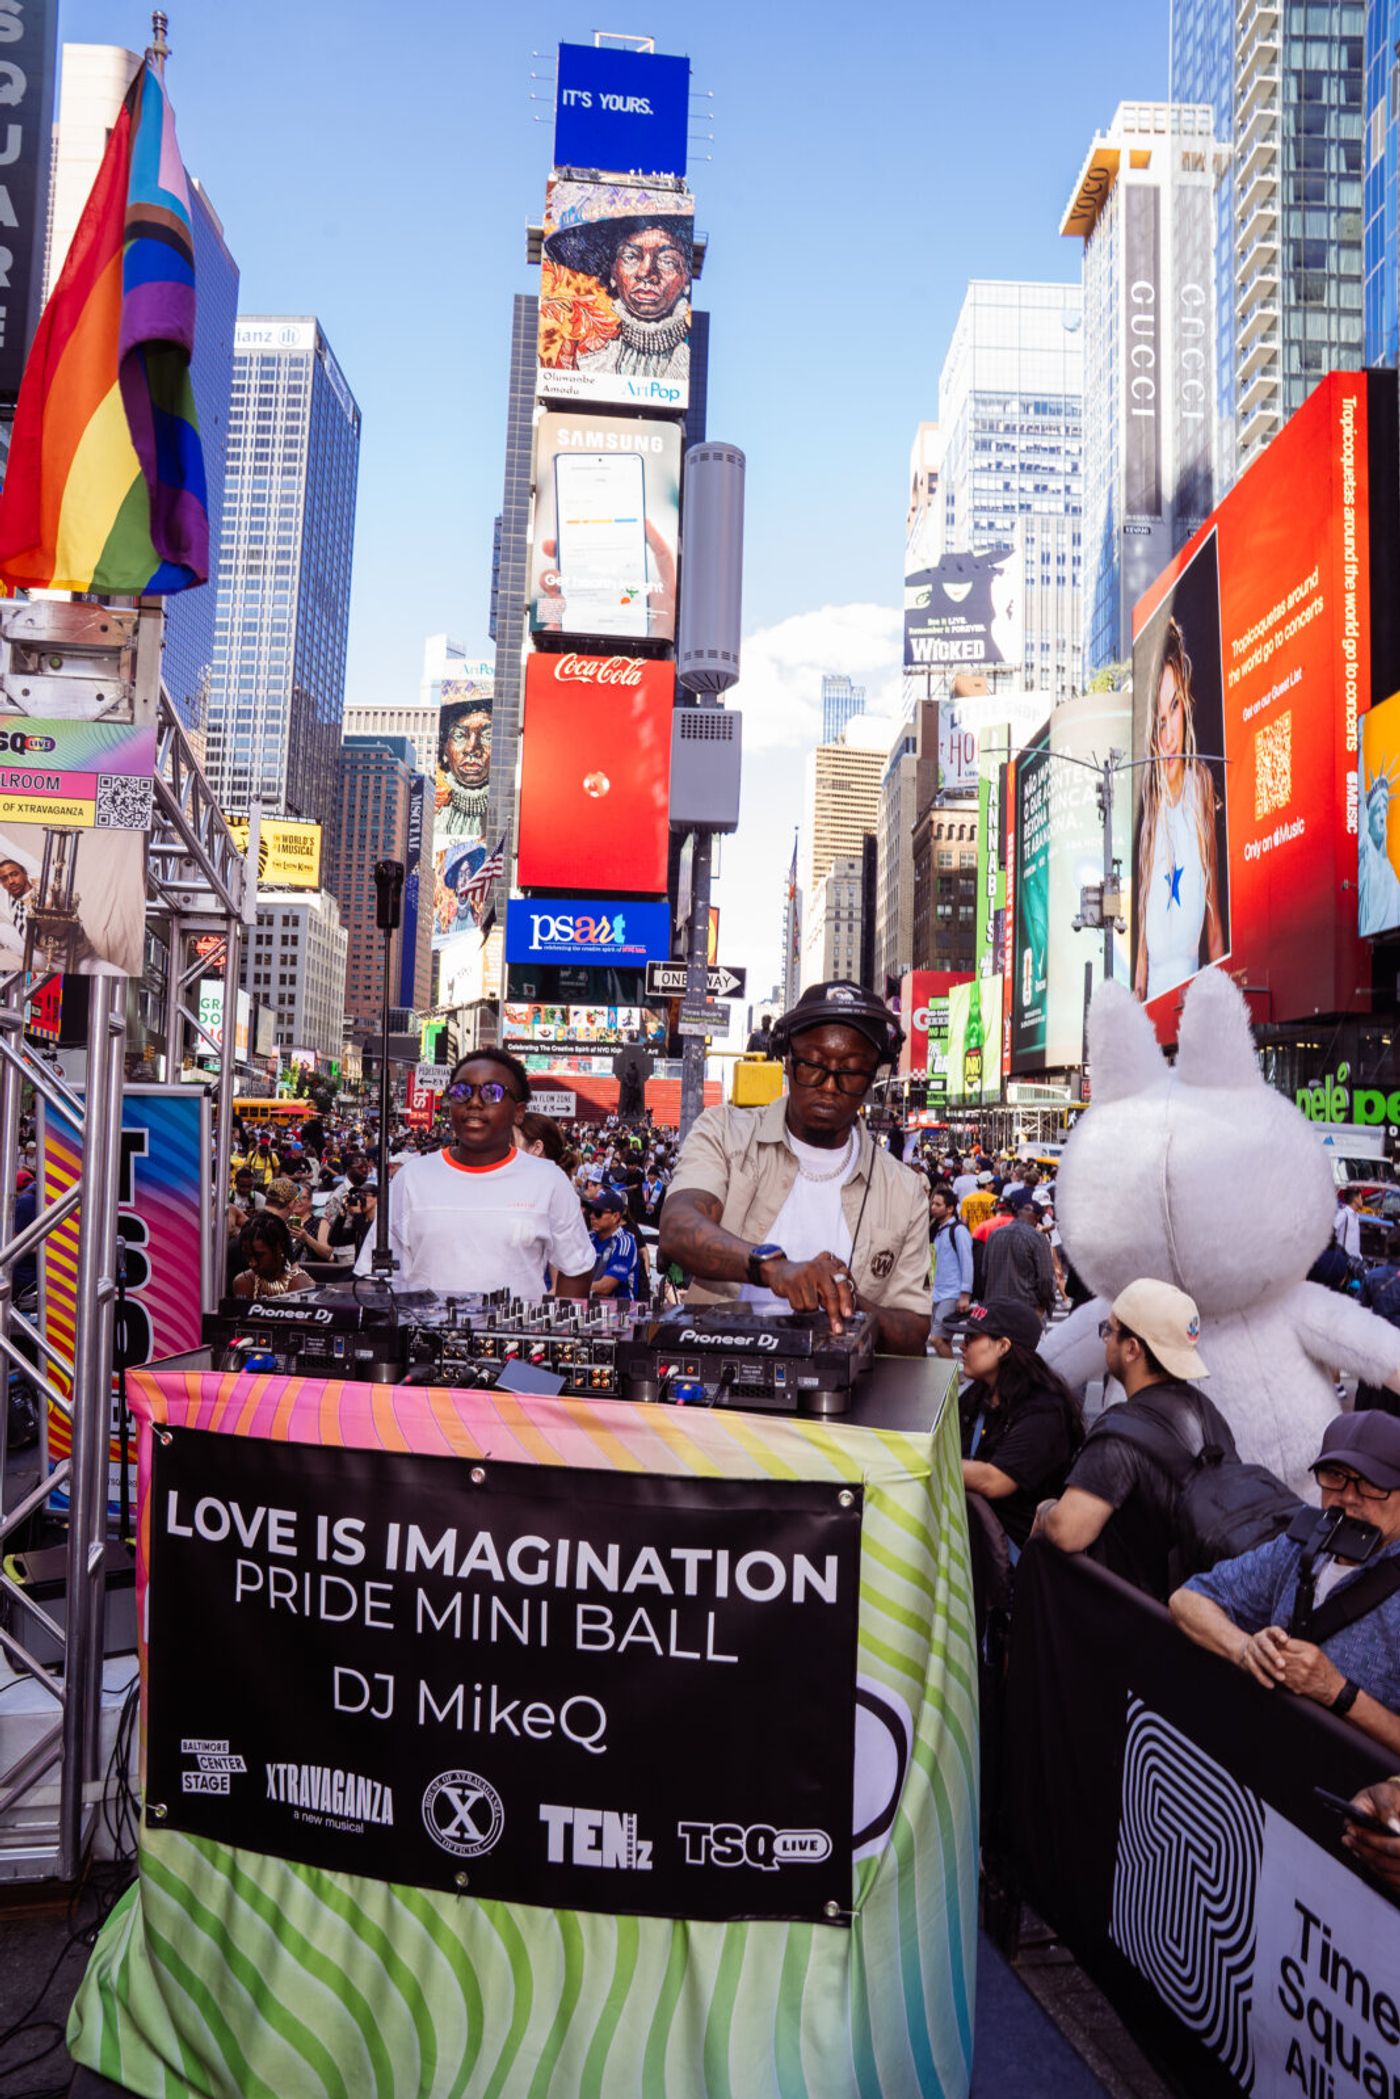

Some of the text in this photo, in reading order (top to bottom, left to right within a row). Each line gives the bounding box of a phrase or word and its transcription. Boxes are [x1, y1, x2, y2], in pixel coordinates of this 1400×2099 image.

[562, 89, 653, 115] IT'S YOURS.
[1131, 280, 1156, 417] GUCCI
[623, 379, 680, 402] ArtPop
[556, 428, 664, 453] SAMSUNG
[544, 574, 569, 587] Get
[1339, 395, 1360, 752] Tropicoquetas around the world go to concerts
[1232, 565, 1319, 657] Tropicoquetas around
[1228, 596, 1324, 688] the world go to concerts
[463, 663, 494, 676] ArtPo
[554, 653, 647, 686] Coca-Cola
[1242, 667, 1303, 723] Get on our Guest List
[28, 739, 50, 748] LIVE
[3, 802, 84, 816] OF XTRAVAGANZA
[281, 833, 315, 846] WORLD'S
[281, 844, 314, 856] MUSICAL
[1244, 817, 1305, 862] Only on Music
[529, 913, 626, 950] psart
[661, 972, 731, 988] ONE WAY
[508, 1044, 539, 1052] Celebrating
[247, 1303, 313, 1320] Pioneer
[679, 1329, 755, 1347] Pioneer
[166, 1490, 839, 1604] LOVE IS IMAGINATION
[235, 1558, 739, 1664] PRIDE MINI BALL
[333, 1666, 607, 1755] DJ MikeQ
[182, 1740, 229, 1753] BALTIMORE
[199, 1755, 245, 1771] CENTER
[183, 1773, 229, 1792] STAGE
[265, 1763, 394, 1826] XTRAVAGANZA
[293, 1811, 365, 1834] a new musical
[440, 1786, 485, 1841] X
[677, 1821, 819, 1872] TSQ LIVE
[1278, 1954, 1400, 2099] Squa
